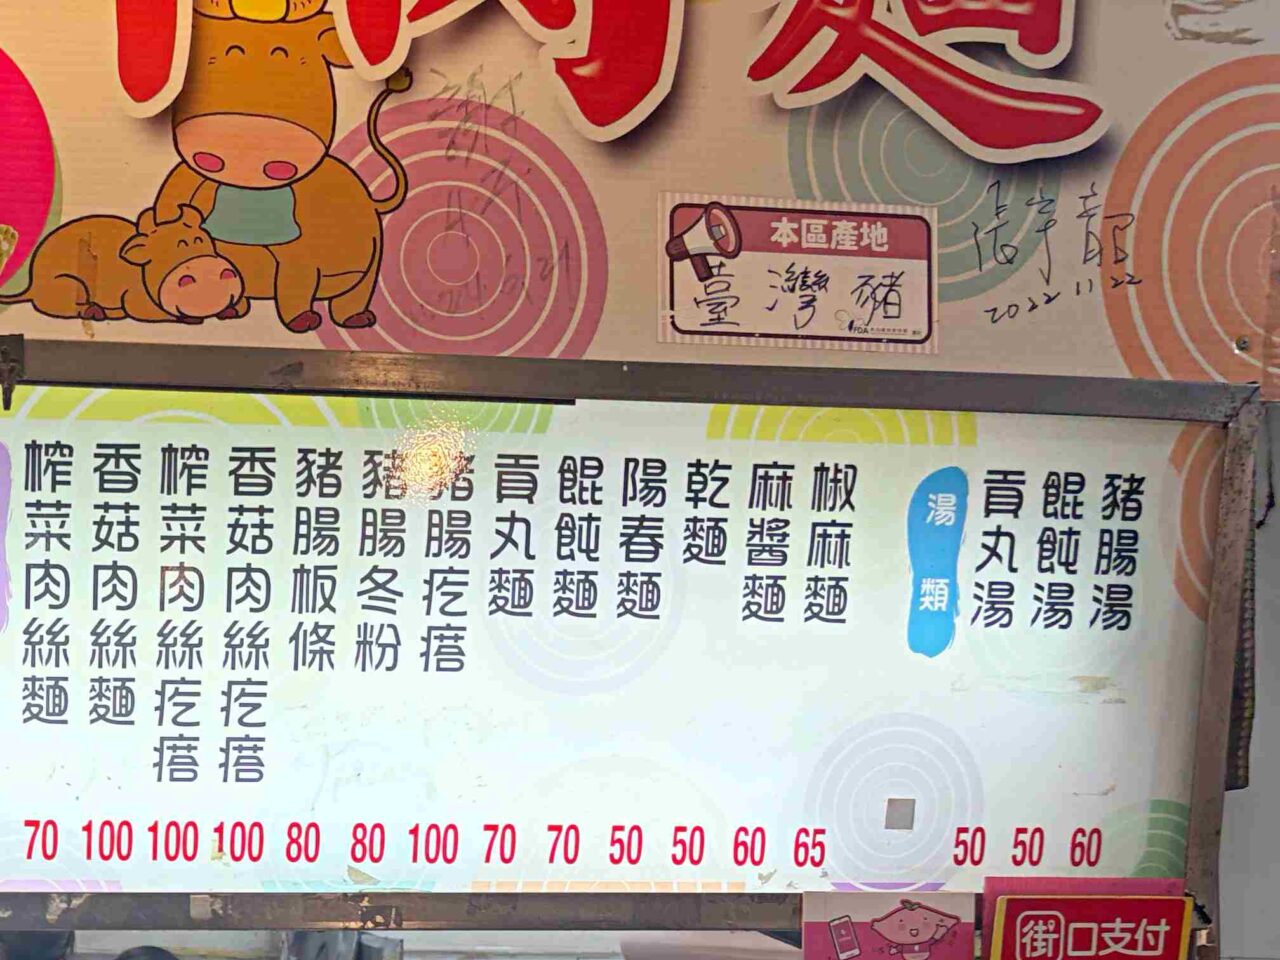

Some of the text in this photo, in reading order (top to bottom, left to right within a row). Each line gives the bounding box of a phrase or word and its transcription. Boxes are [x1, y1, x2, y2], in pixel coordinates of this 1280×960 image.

[770, 217, 889, 252] 本區產地
[984, 292, 1061, 323] 2022
[22, 440, 74, 724] 榨菜肉絲麵
[89, 443, 141, 725] 香菇肉絲麵
[289, 448, 343, 671] 豬腸板條
[355, 450, 406, 671] 豬腸冬粉
[488, 453, 540, 617] 貢丸麵
[553, 456, 605, 618] 餛飩麵
[617, 457, 667, 620] 陽春麵
[683, 459, 732, 565] 乾麵
[742, 460, 795, 622] 麻醬麵
[804, 462, 857, 623] 椒麻麵
[920, 492, 957, 612] 湯類
[971, 470, 1026, 628] 貢丸湯
[1030, 471, 1085, 629] 餛飩湯
[1089, 473, 1145, 631] 豬腸湯
[153, 443, 209, 782] 榨菜肉絲疙瘩
[219, 446, 276, 783] 香菇肉絲疙瘩
[24, 820, 825, 867] 70 100 100 100 80 80 100 70 70 50 50 60 65
[954, 827, 1101, 866] 50 50 60
